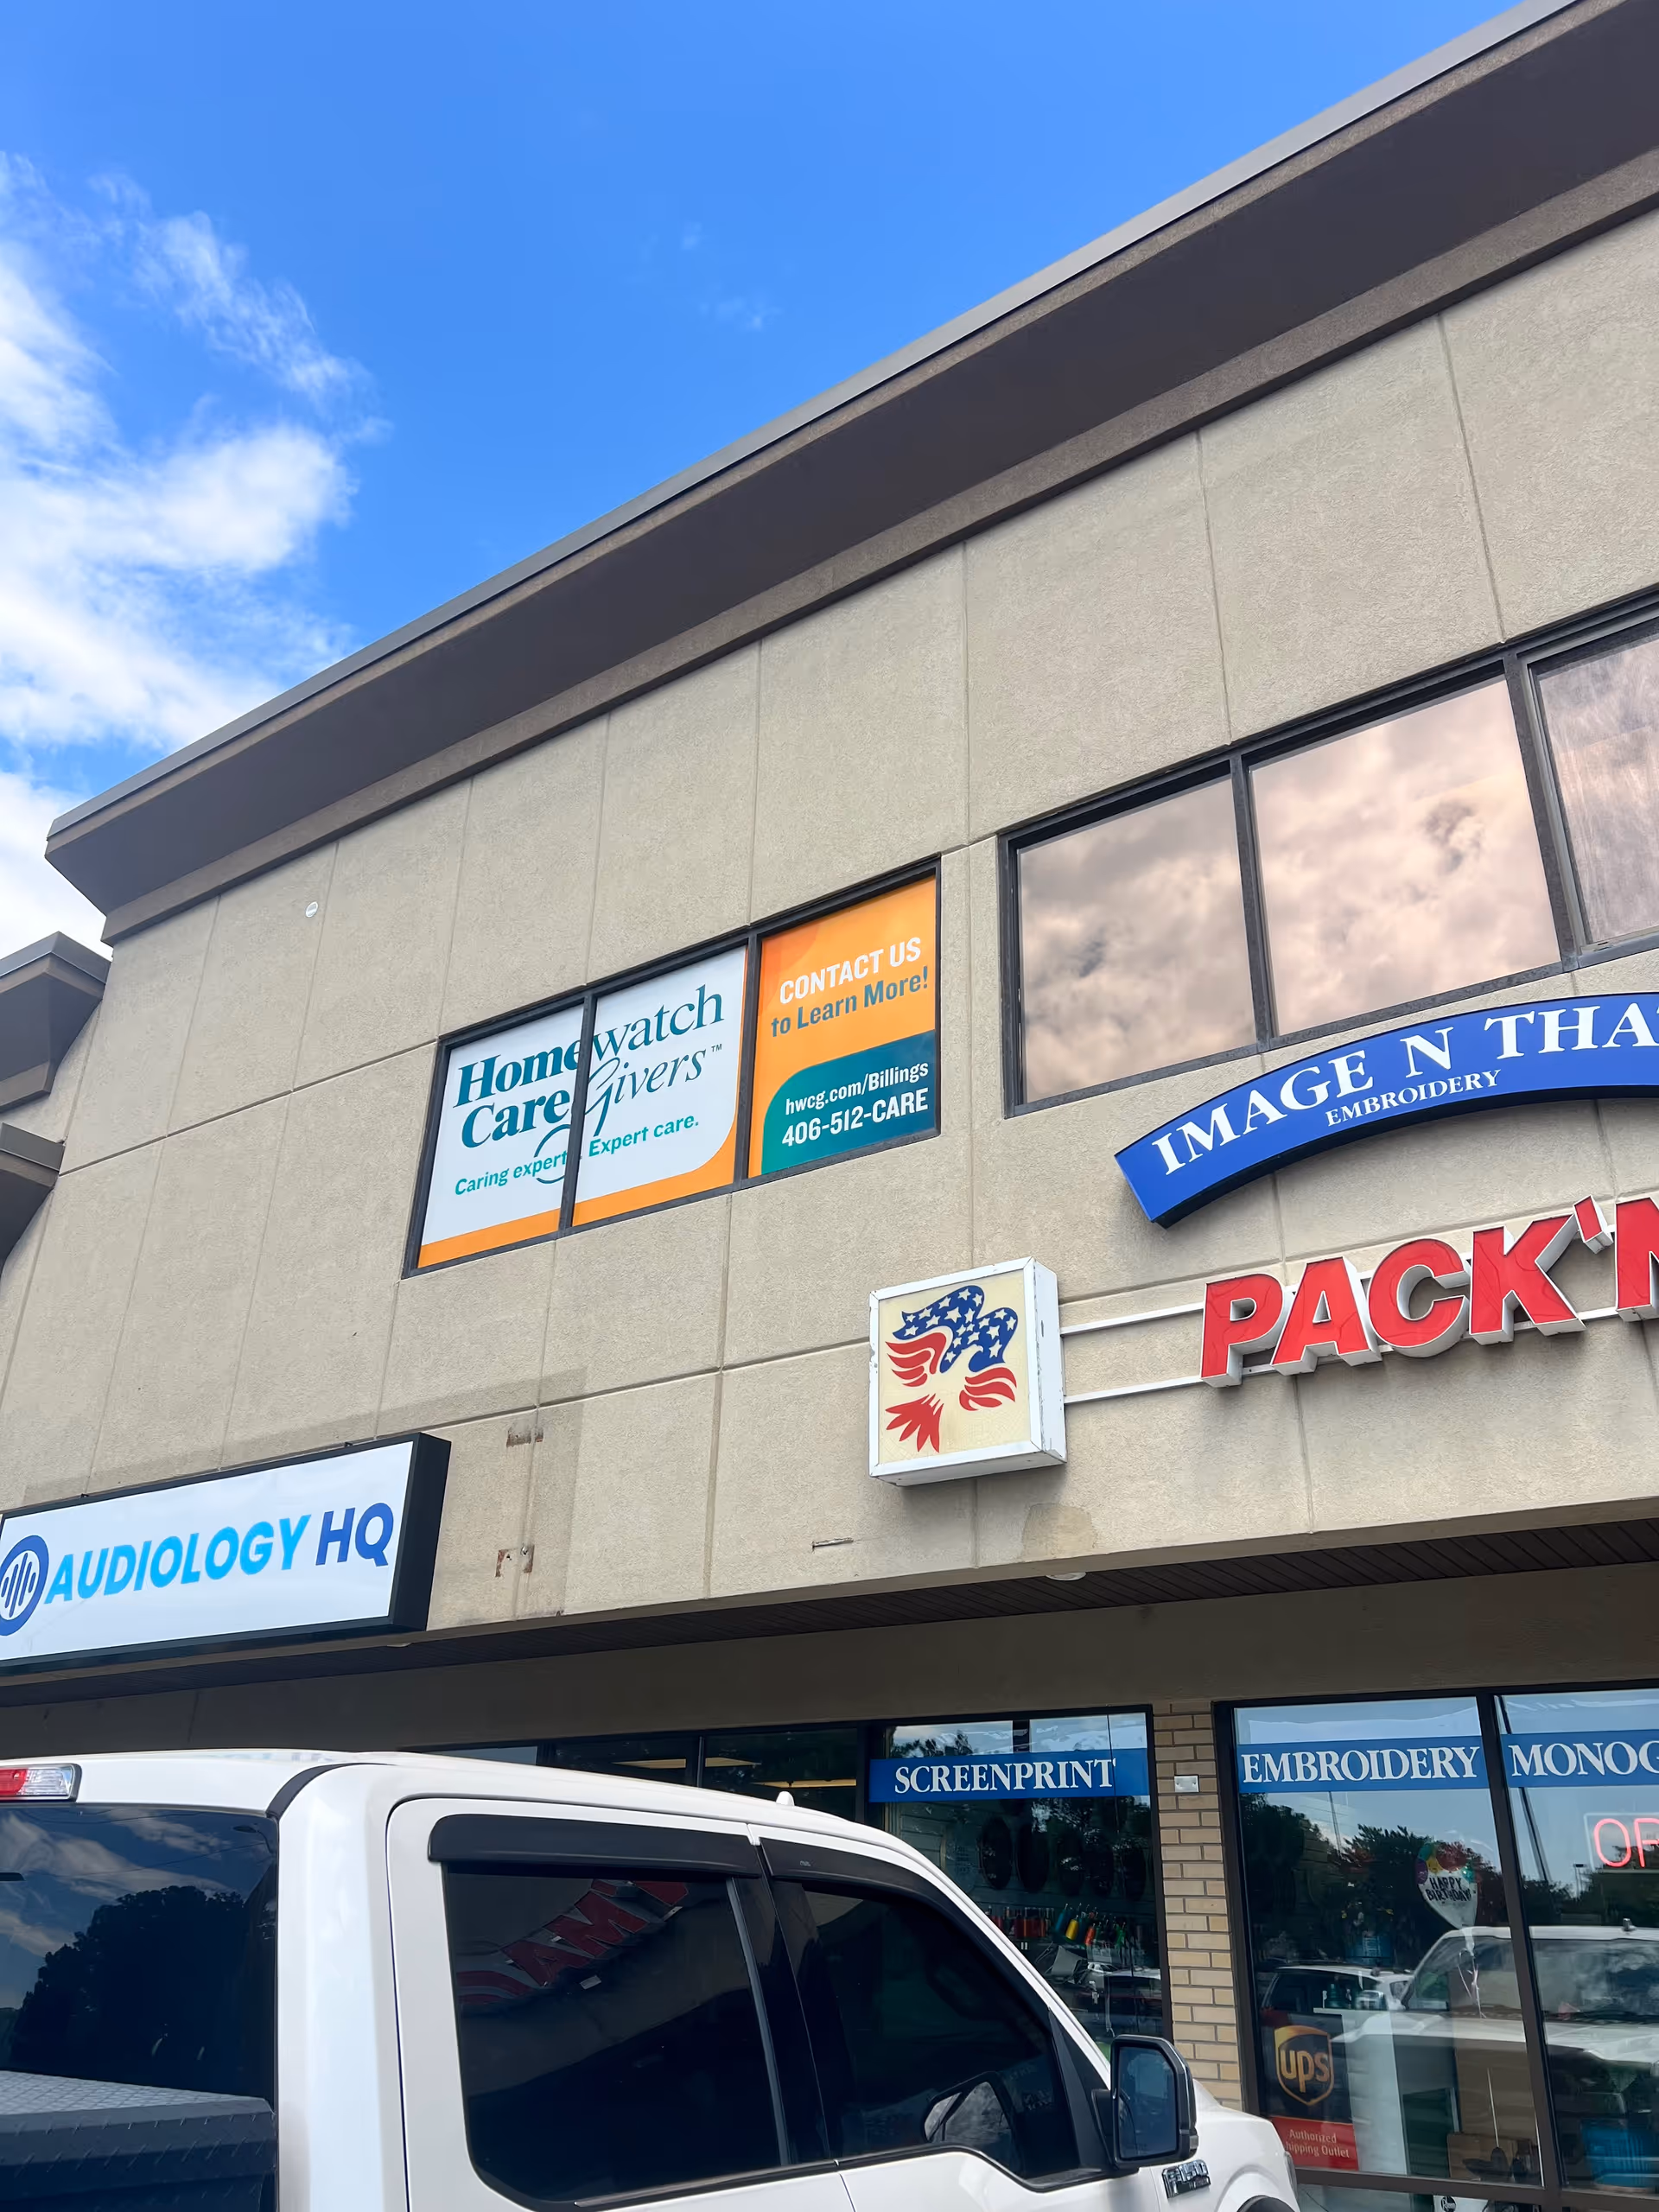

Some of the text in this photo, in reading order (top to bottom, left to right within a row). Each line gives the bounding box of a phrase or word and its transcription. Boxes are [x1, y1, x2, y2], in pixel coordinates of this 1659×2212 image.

[779, 937, 921, 1004] CONTACT US
[772, 966, 928, 1037] to Learn More!
[785, 1062, 929, 1115] hwcg.com/Billings
[1152, 1002, 1659, 1175] IMAGE N THA
[1325, 1069, 1502, 1128] EMBROIDERY
[782, 1088, 929, 1147] 406-512-CARE
[454, 1115, 699, 1196] Caring expert Expert care.
[44, 1502, 395, 1605] AUDIOLOGY HQ
[894, 1758, 1116, 1794] SCREENPRINT
[1241, 1745, 1480, 1784] EMBROIDERY
[1429, 1877, 1462, 1891] HAPPY
[1281, 2049, 1330, 2093] ups
[1286, 2141, 1350, 2158] hipping Outlet
[1289, 2128, 1337, 2143] Authorized
